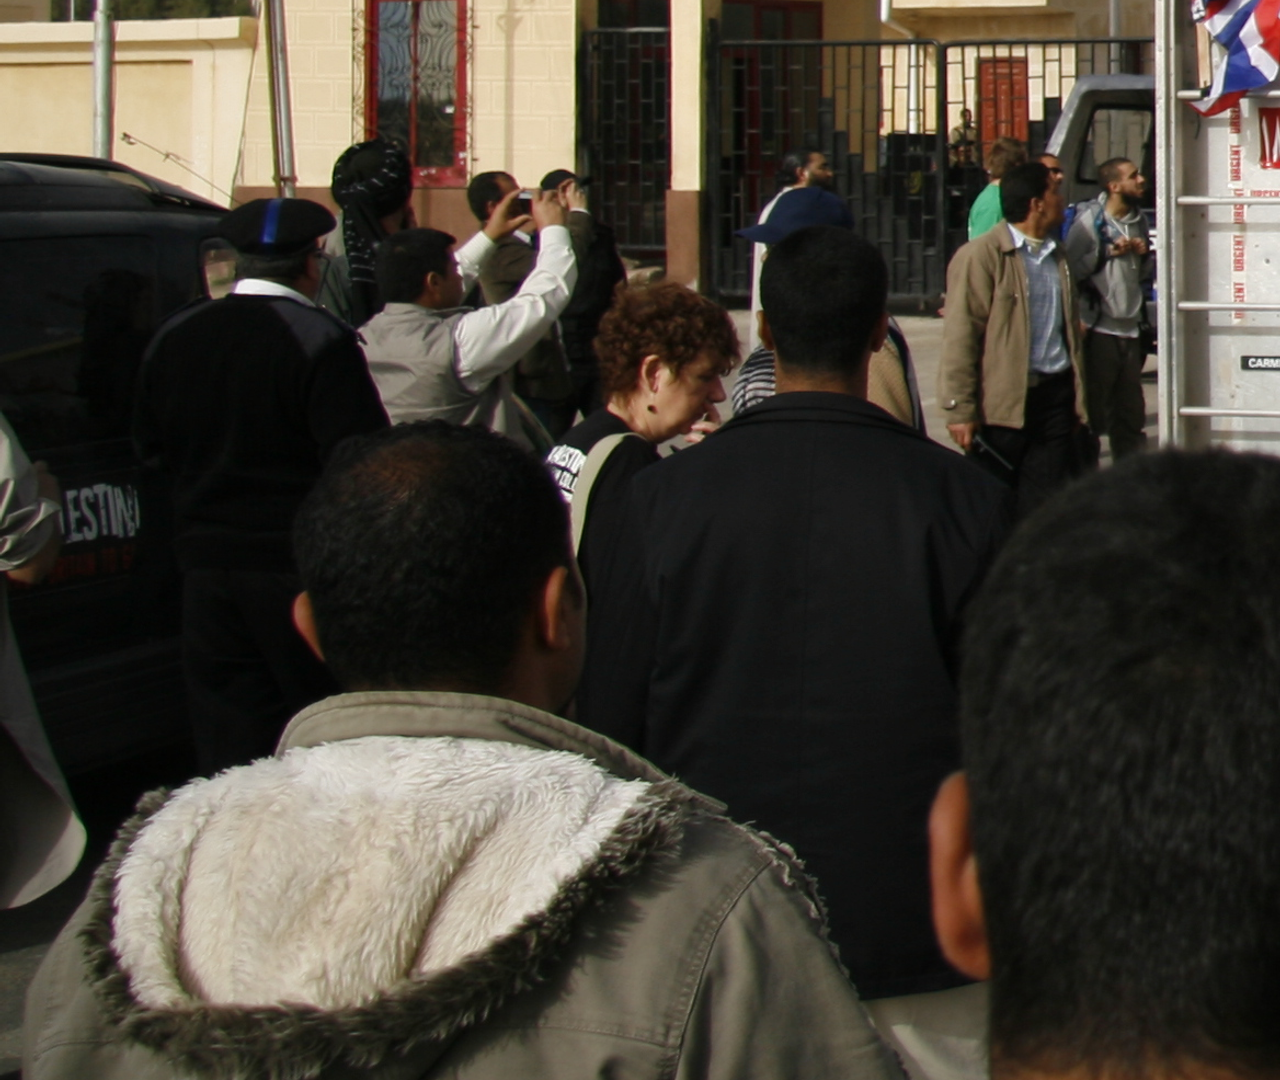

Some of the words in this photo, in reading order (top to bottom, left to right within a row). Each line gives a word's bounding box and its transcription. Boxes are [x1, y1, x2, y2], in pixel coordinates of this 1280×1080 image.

[1230, 145, 1241, 181] URGENT
[1233, 235, 1244, 271] URGENT
[59, 484, 140, 544] ESTIN
